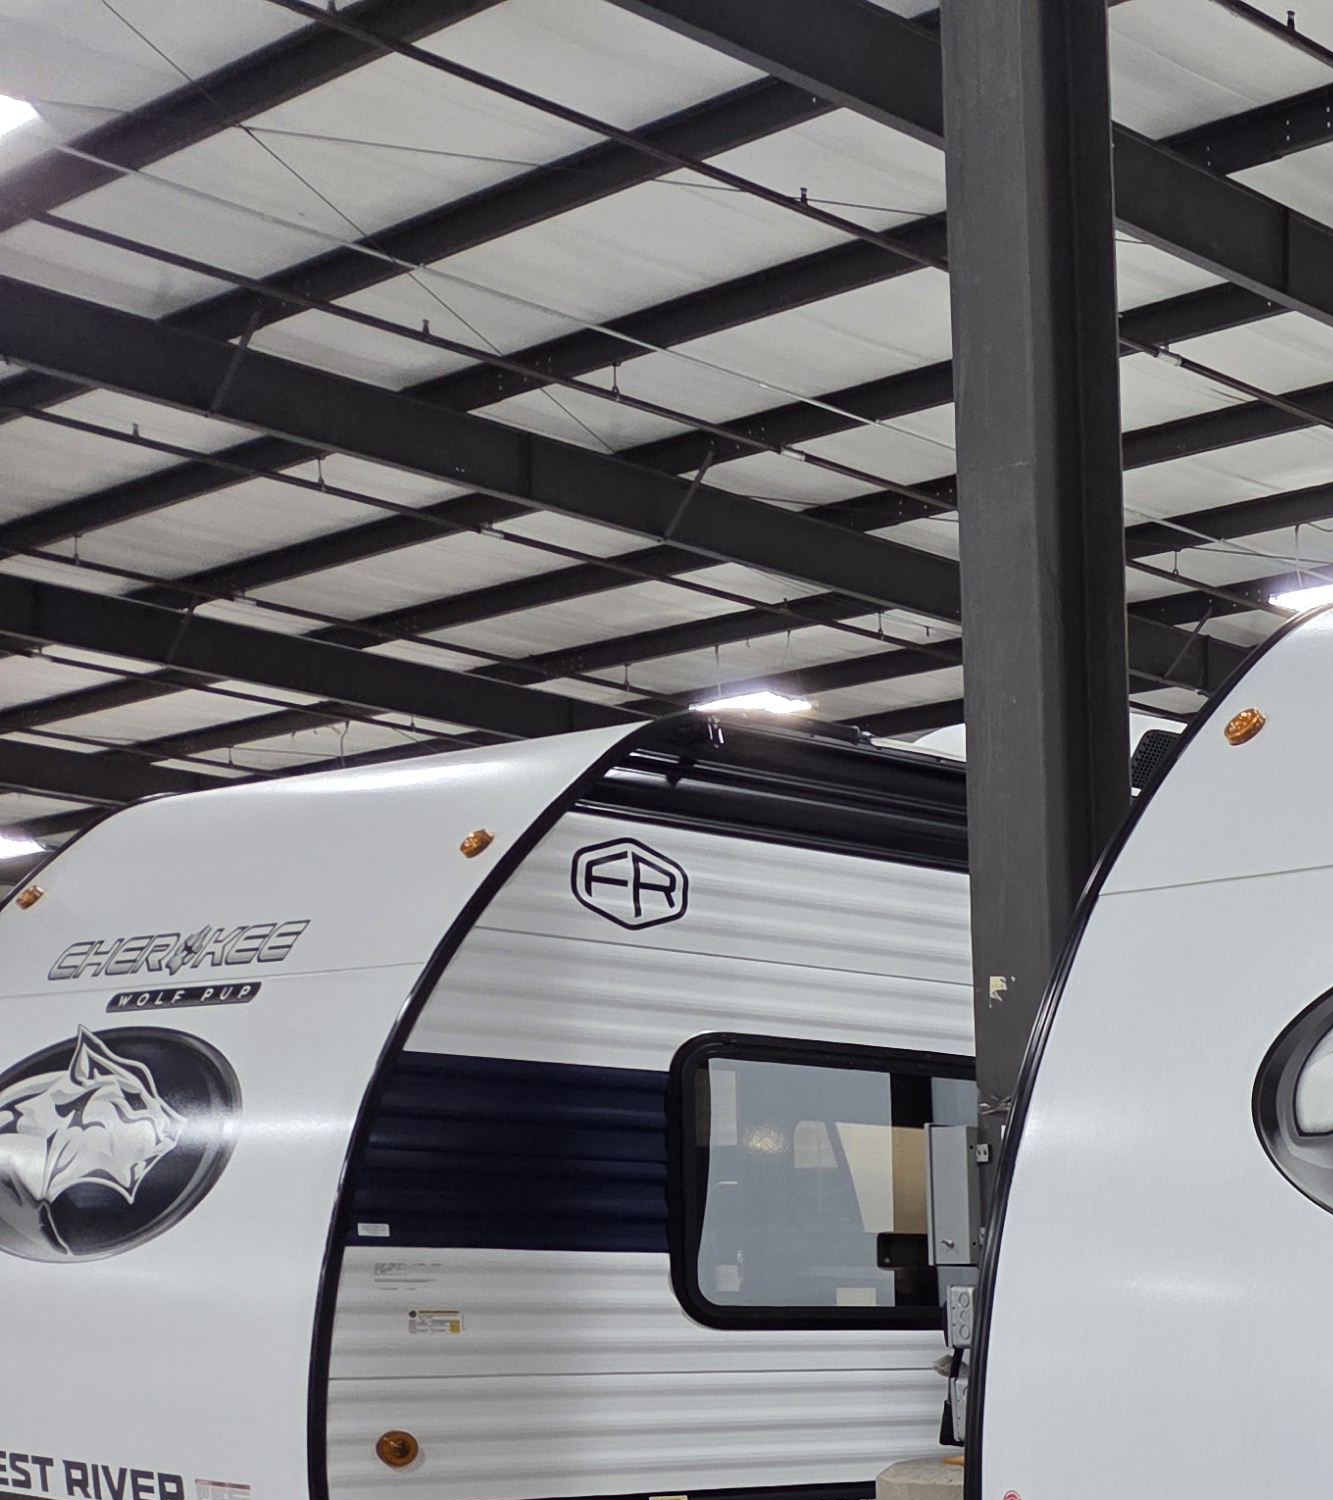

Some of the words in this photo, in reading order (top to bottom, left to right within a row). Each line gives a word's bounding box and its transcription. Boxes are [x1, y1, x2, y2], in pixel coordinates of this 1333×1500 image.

[48, 919, 311, 981] CHEROKEE
[117, 988, 186, 1007] WOLF
[200, 984, 252, 1003] PUP
